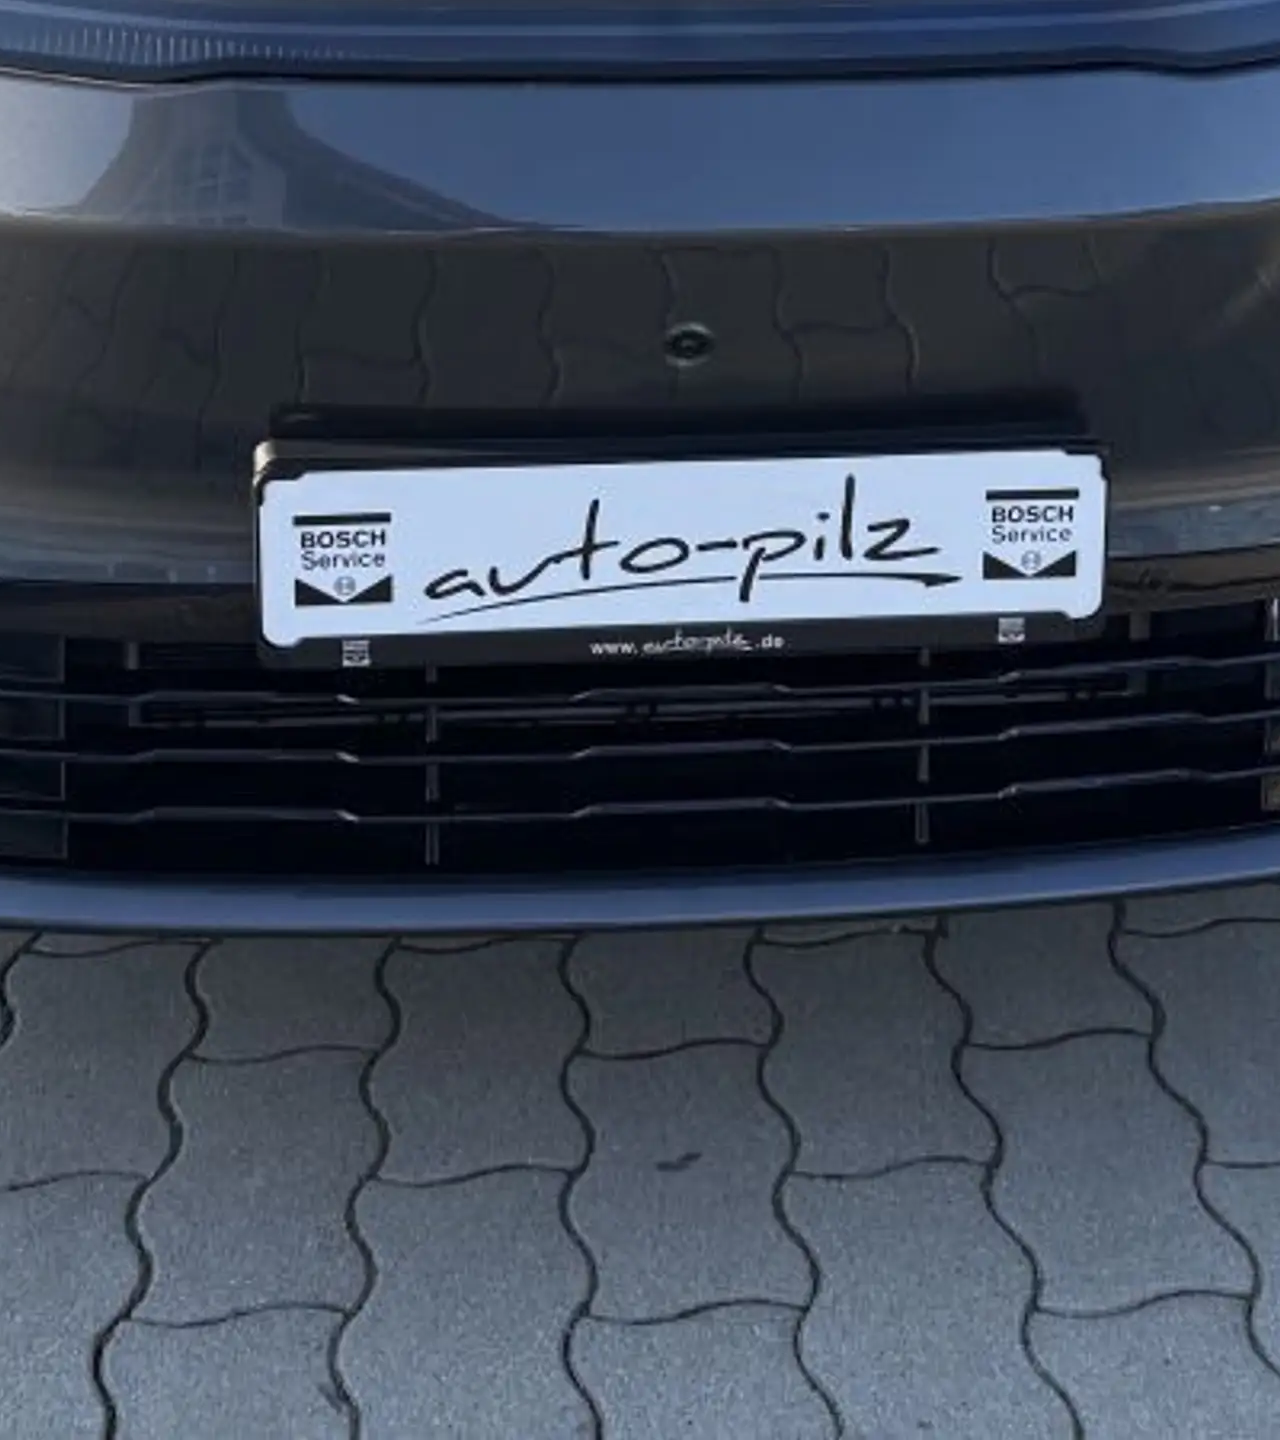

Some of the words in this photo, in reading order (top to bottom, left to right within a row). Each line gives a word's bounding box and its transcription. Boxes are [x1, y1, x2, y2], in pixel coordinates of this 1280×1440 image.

[991, 505, 1074, 524] BOSCH
[300, 529, 386, 549] BOSCH
[422, 473, 940, 602] auto-pilz
[991, 524, 1073, 544] Service
[300, 549, 386, 571] Service
